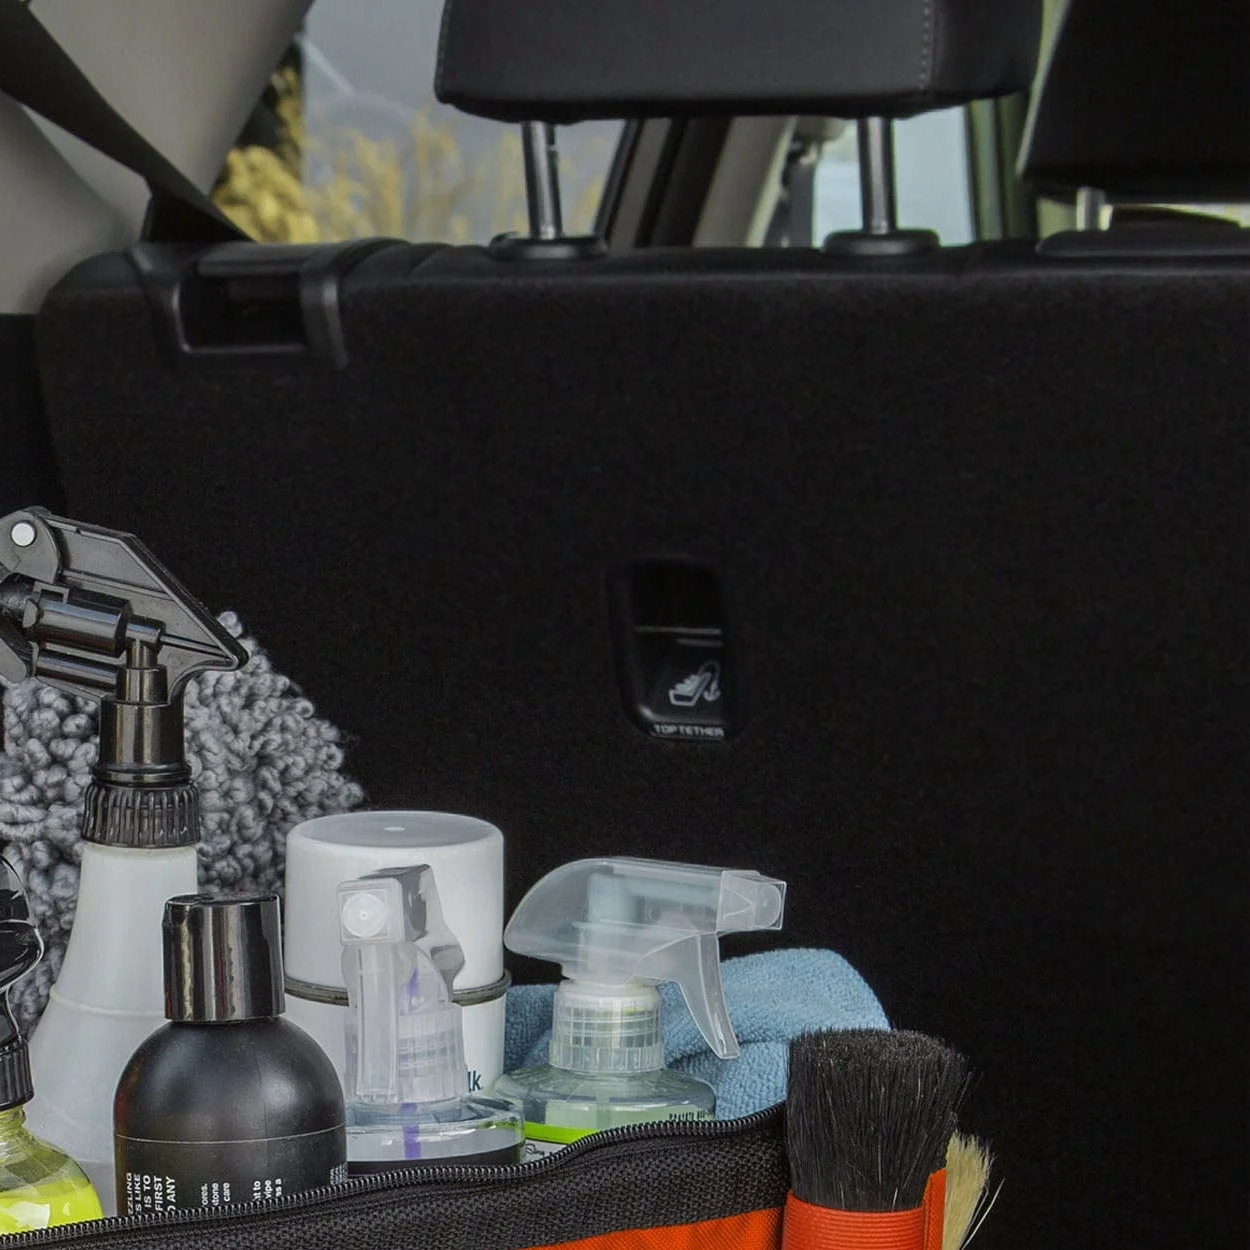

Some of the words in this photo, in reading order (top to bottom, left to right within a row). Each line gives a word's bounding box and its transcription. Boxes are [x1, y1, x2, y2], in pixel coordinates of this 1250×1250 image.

[653, 724, 678, 734] TOP
[133, 1173, 141, 1201] LIKE
[143, 1174, 151, 1192] TO
[153, 1175, 164, 1212] FIRST
[166, 1176, 176, 1203] ANY
